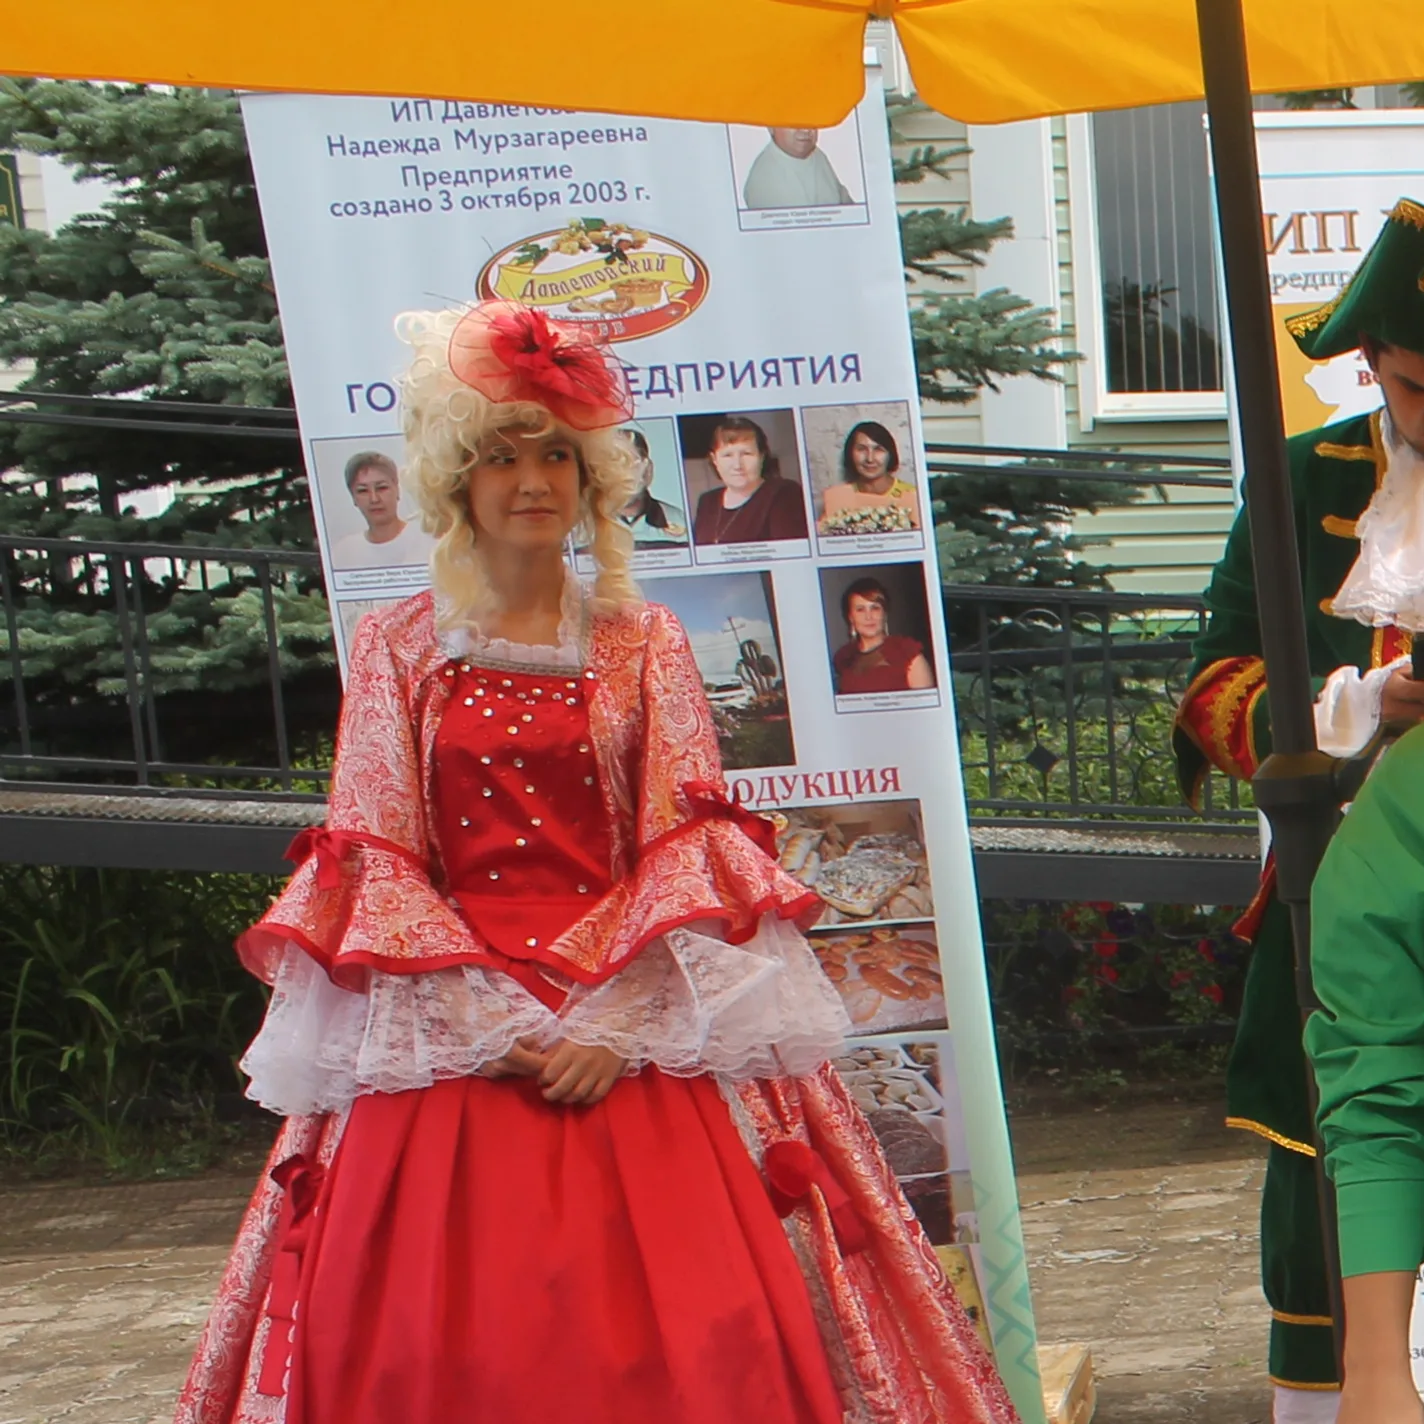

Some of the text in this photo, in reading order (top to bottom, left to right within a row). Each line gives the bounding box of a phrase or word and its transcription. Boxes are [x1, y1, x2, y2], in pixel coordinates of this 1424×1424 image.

[391, 100, 432, 122] ИП
[327, 126, 648, 159] Надежда Мурзагареевна
[401, 164, 573, 190] Предприятие
[330, 181, 651, 217] создано 3 октября 2003 г.
[1263, 210, 1361, 255] ИП
[730, 766, 901, 808] ОДУКЦИЯ
